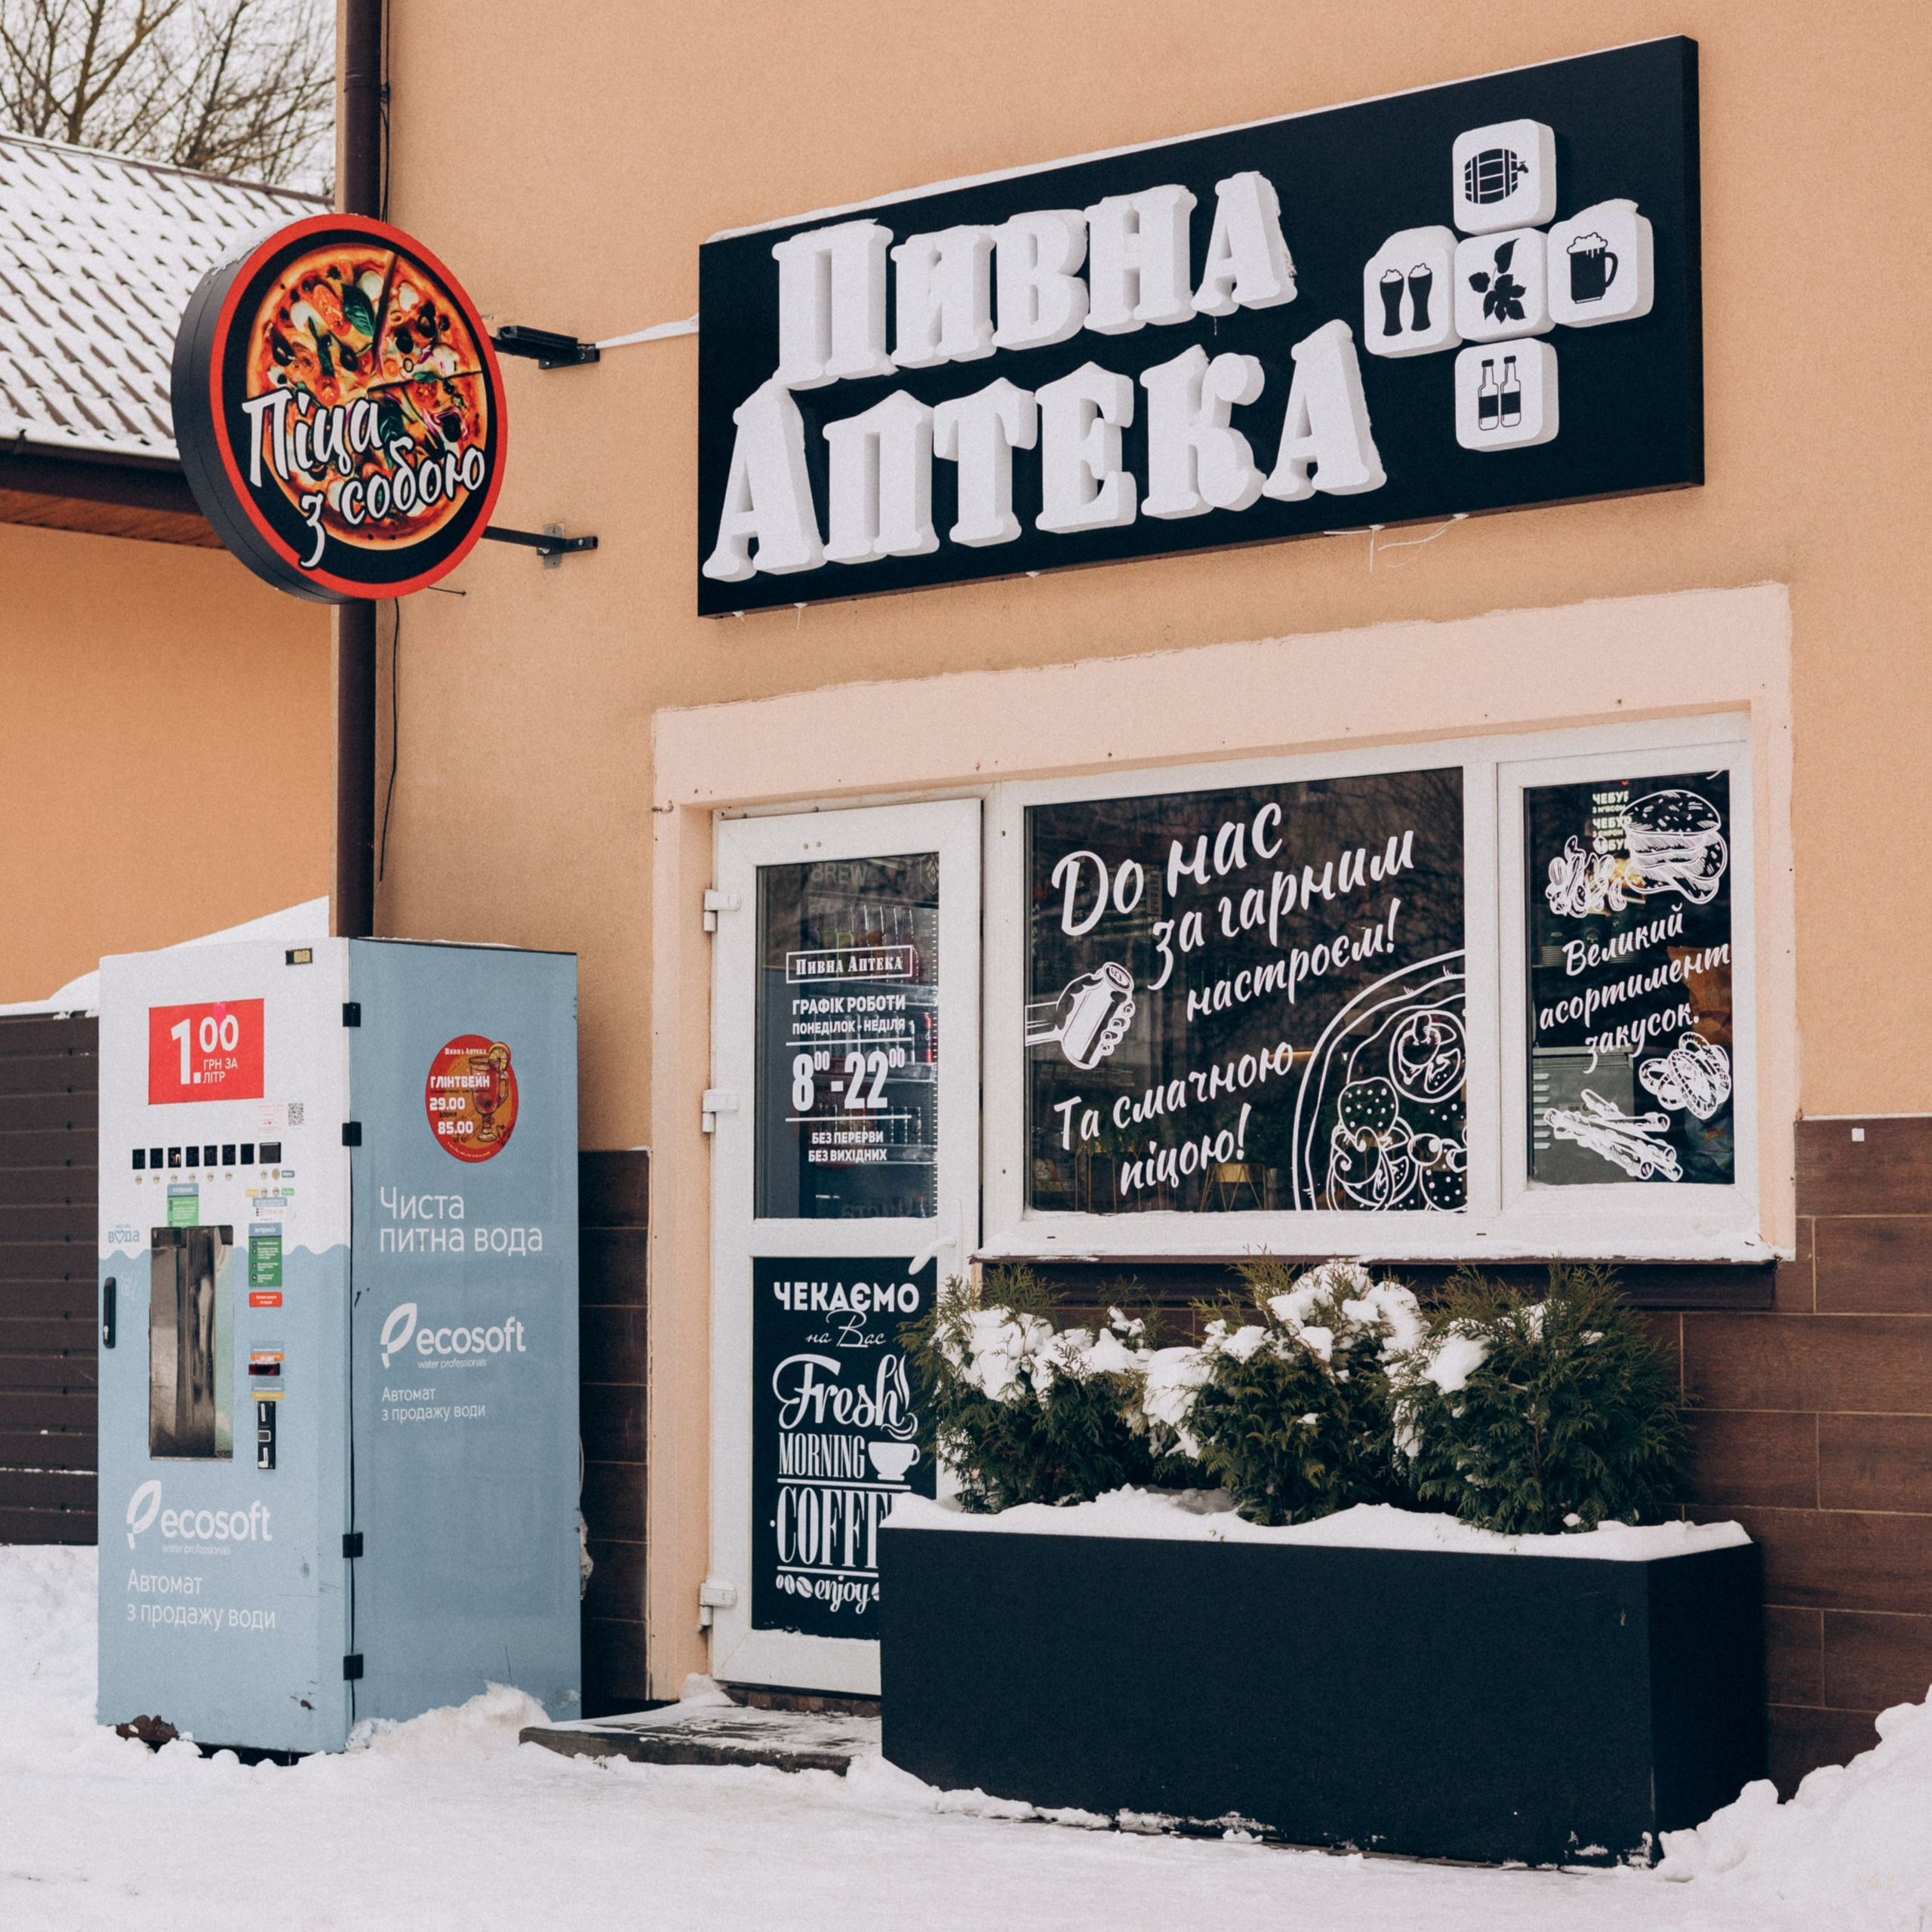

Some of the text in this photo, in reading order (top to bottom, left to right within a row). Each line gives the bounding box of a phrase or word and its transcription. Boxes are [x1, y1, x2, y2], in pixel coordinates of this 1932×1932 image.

[242, 390, 382, 487] Піца
[300, 439, 485, 567] з собою
[1051, 851, 1144, 936] До
[1168, 803, 1282, 897] нас
[1147, 830, 1414, 990] за гарним
[1562, 903, 1683, 976] Великий
[1186, 897, 1401, 1021] настроєм!
[1540, 943, 1730, 1029] асортимент
[792, 995, 906, 1015] ГРАФІК РОБОТИ
[792, 1020, 855, 1035] ПОНЕДІЛОК
[864, 1018, 906, 1033] НЕДІЛЯ
[1583, 1002, 1699, 1074] закусок.
[203, 1057, 238, 1070] ГРН ЗА
[203, 1072, 226, 1084] ЛІТР
[430, 1072, 490, 1088] ГЛІНТВЕЙН
[429, 1097, 466, 1111] 29.00
[1054, 1042, 1294, 1150] Та смачною
[438, 1121, 473, 1135] 85.00
[812, 1131, 884, 1145] БЕЗ ПЕРЕРВИ
[808, 1148, 887, 1162] БЕЗ ВИХІДНИХ
[1121, 1103, 1251, 1195] піцою!
[380, 1186, 464, 1220] Чиста
[380, 1227, 542, 1257] питна вода
[774, 1281, 920, 1312] ЧЕКАЄМО
[417, 1316, 526, 1355] ecosoft
[805, 1309, 886, 1347] на Вас
[418, 1358, 487, 1369] water professionals
[382, 1386, 435, 1402] Автомат
[772, 1353, 906, 1429] Fresh
[382, 1405, 485, 1423] з продажу води
[778, 1432, 866, 1479] MORNING
[161, 1500, 272, 1541] ecosoft
[127, 1568, 202, 1595] Автомат
[814, 1575, 871, 1614] enjoy
[127, 1604, 275, 1631] з продажу води
